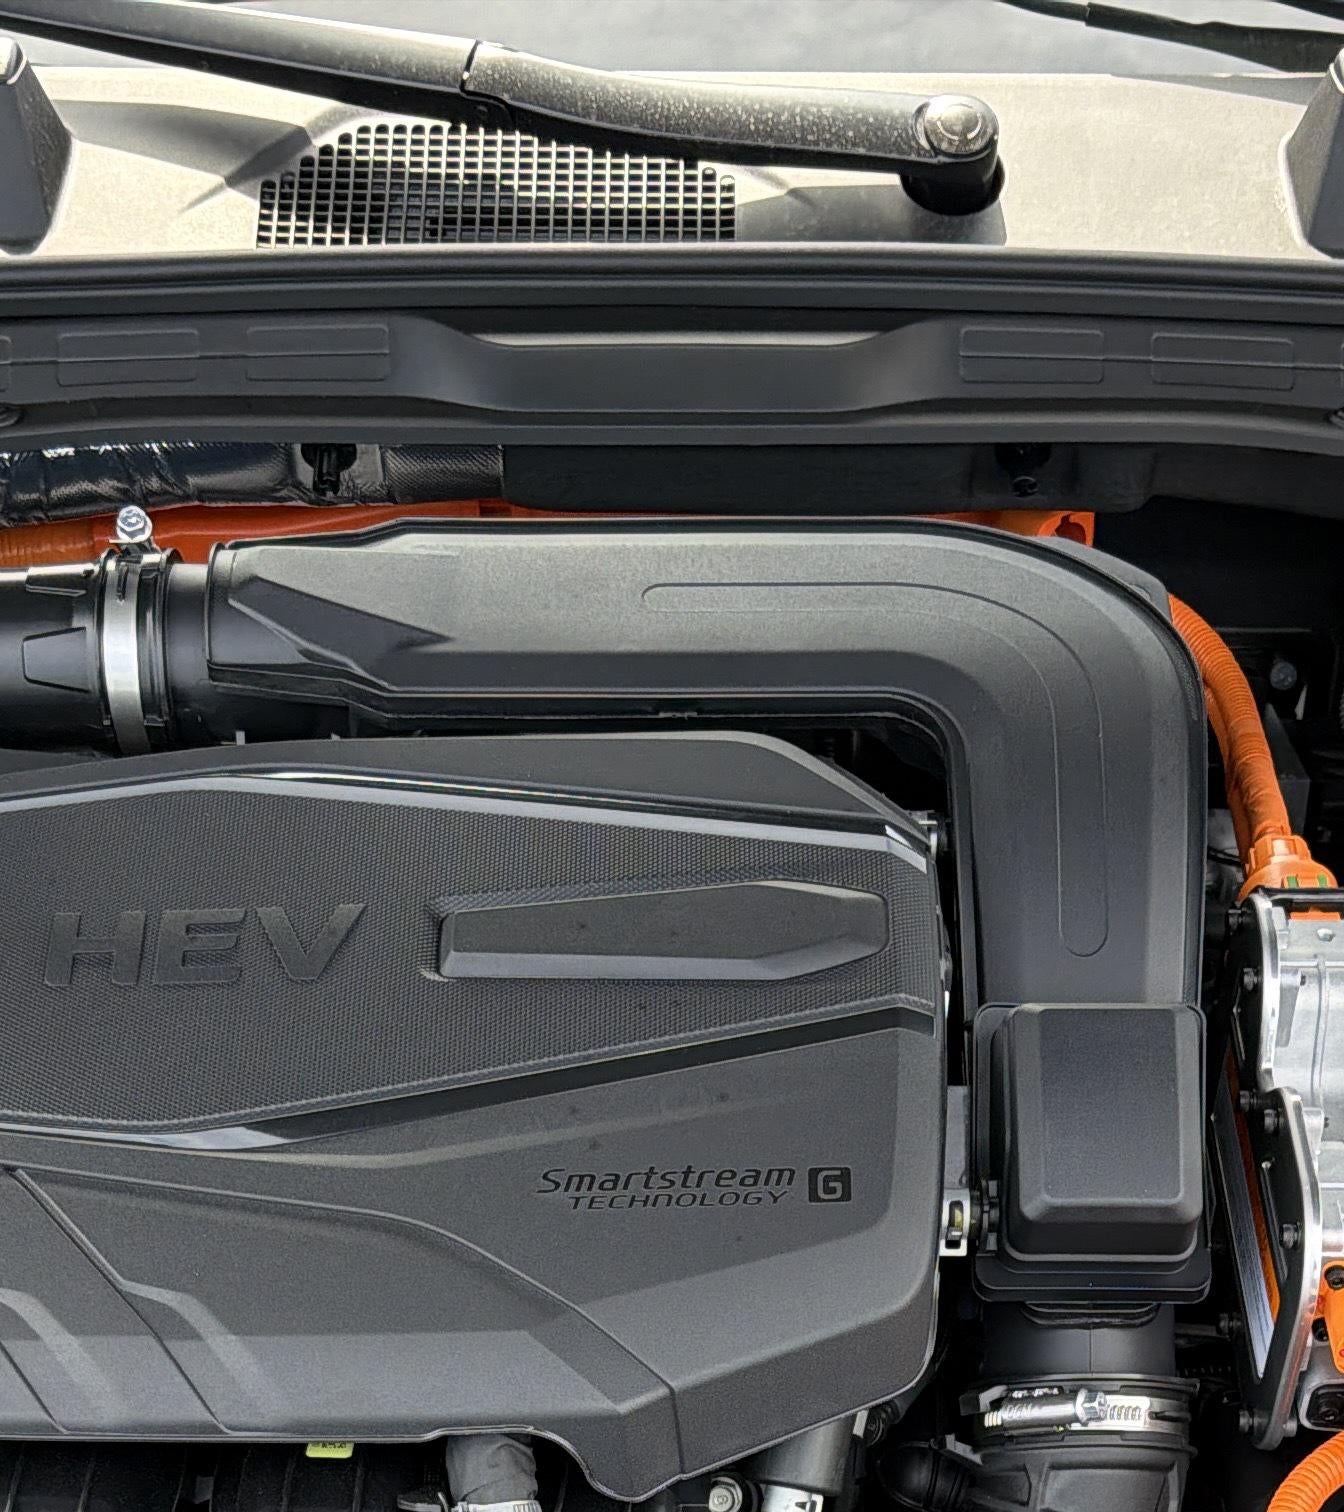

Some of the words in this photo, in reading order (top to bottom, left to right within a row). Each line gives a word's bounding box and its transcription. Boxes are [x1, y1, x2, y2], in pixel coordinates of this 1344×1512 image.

[44, 902, 367, 987] HEV
[536, 1165, 797, 1194] Smartstream
[816, 1169, 845, 1201] G
[568, 1189, 789, 1211] TECHNOLOGY
